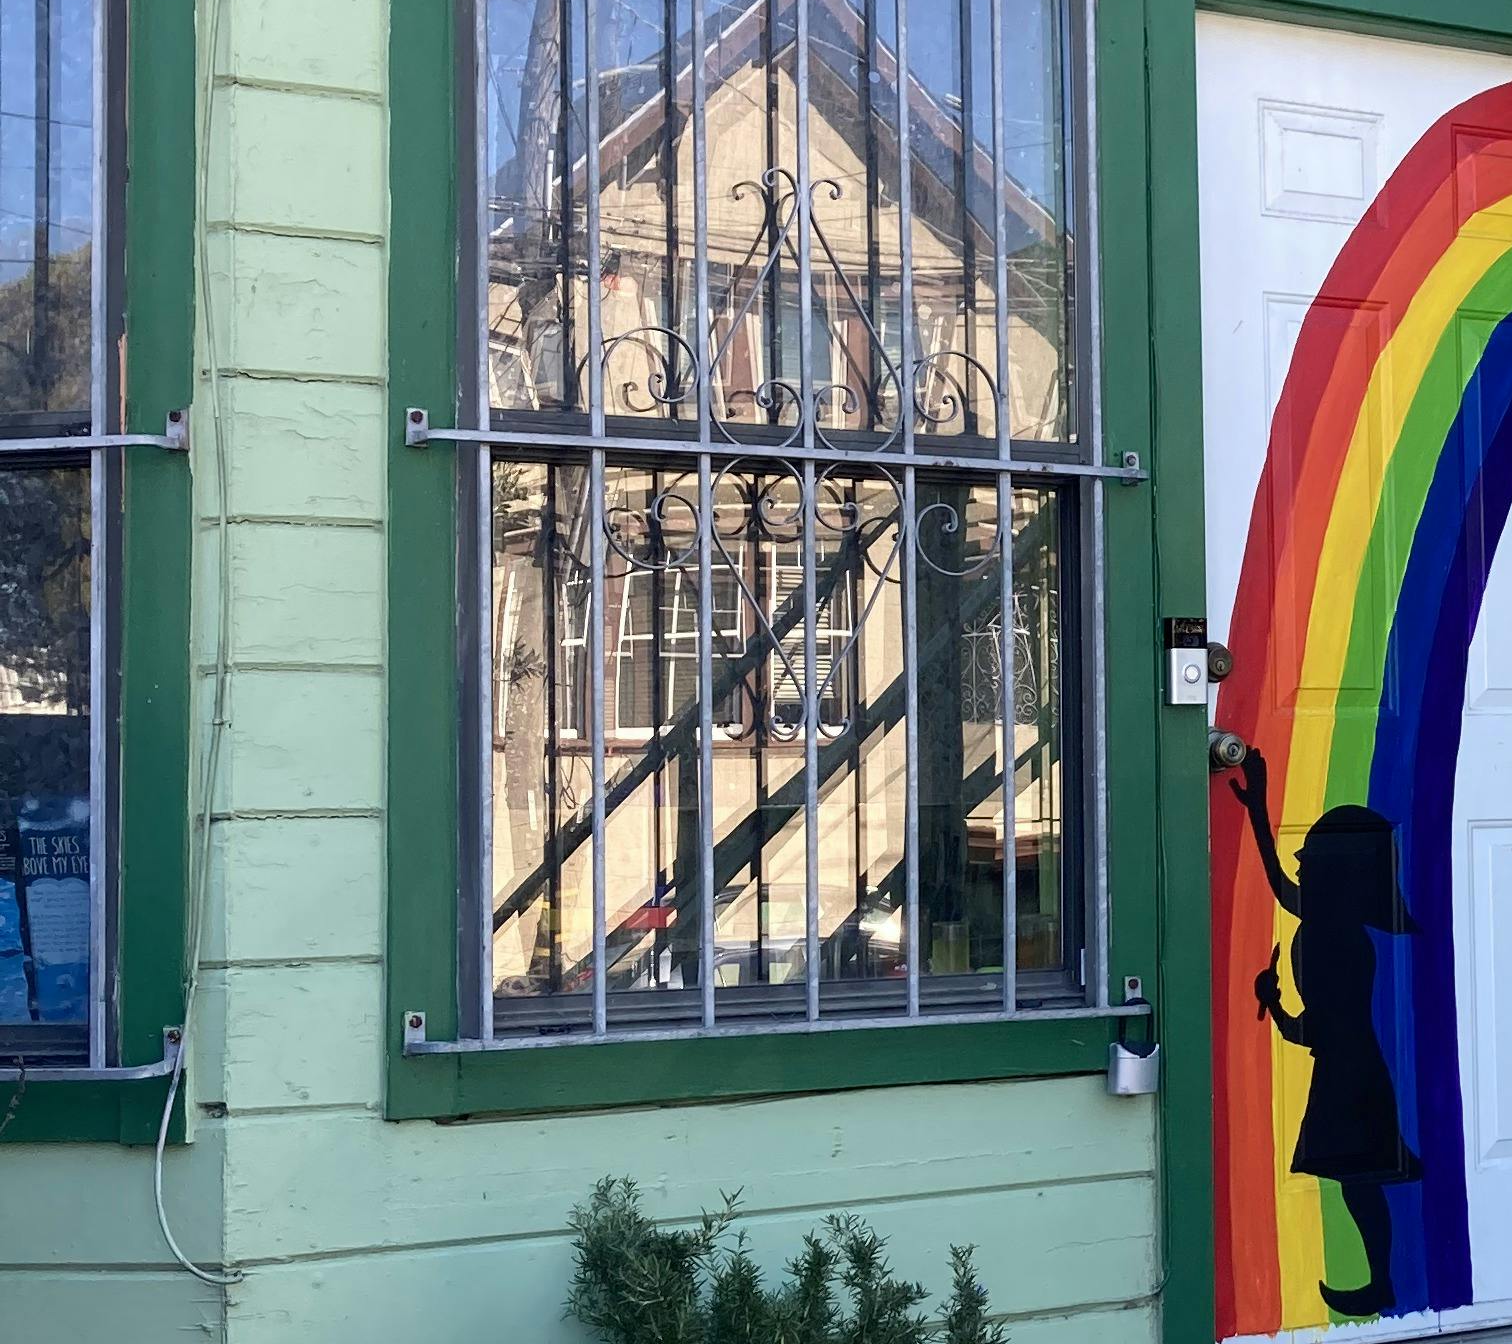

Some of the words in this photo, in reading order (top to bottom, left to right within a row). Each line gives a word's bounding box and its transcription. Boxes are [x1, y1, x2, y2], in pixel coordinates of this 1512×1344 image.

[28, 837, 48, 855] THE
[51, 836, 80, 855] SKIES
[22, 857, 49, 875] BOVE
[51, 856, 68, 874] MY
